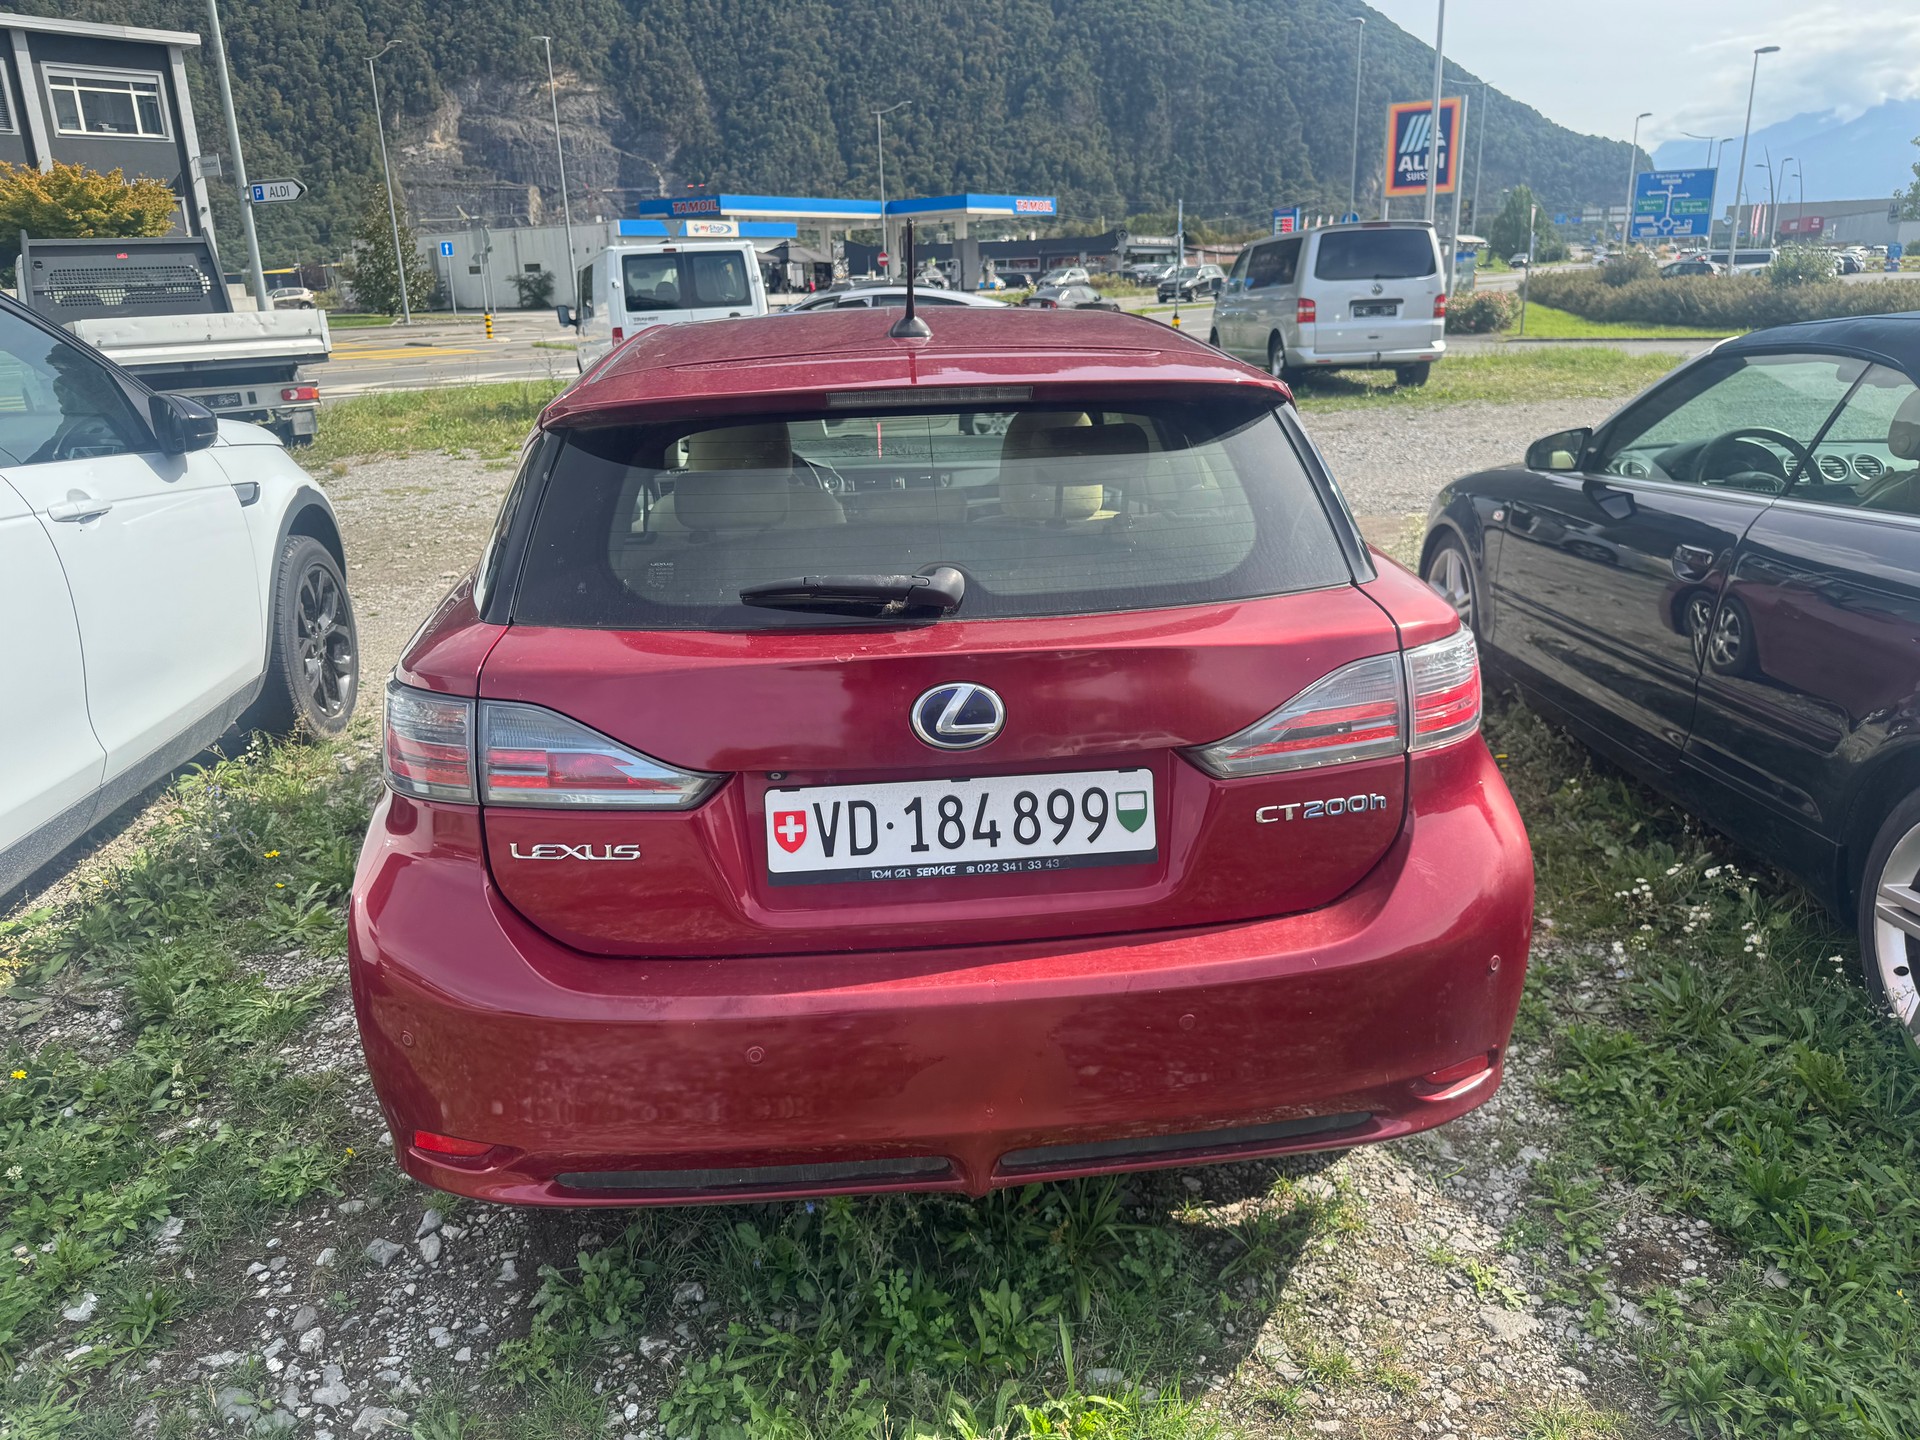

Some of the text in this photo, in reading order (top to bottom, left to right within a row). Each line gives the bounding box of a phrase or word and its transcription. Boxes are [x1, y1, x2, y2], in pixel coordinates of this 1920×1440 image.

[1398, 152, 1445, 172] ALI
[1405, 171, 1428, 182] SUIS
[269, 185, 290, 198] ALDI
[672, 200, 719, 214] TAMOIL
[1016, 199, 1053, 212] TAMOIL
[509, 842, 641, 861] LEXUS
[870, 869, 892, 879] TOM
[916, 865, 957, 877] SERVICE
[977, 863, 999, 873] 022
[1002, 862, 1023, 872] 341
[1027, 860, 1042, 870] 33
[1045, 858, 1060, 869] 43
